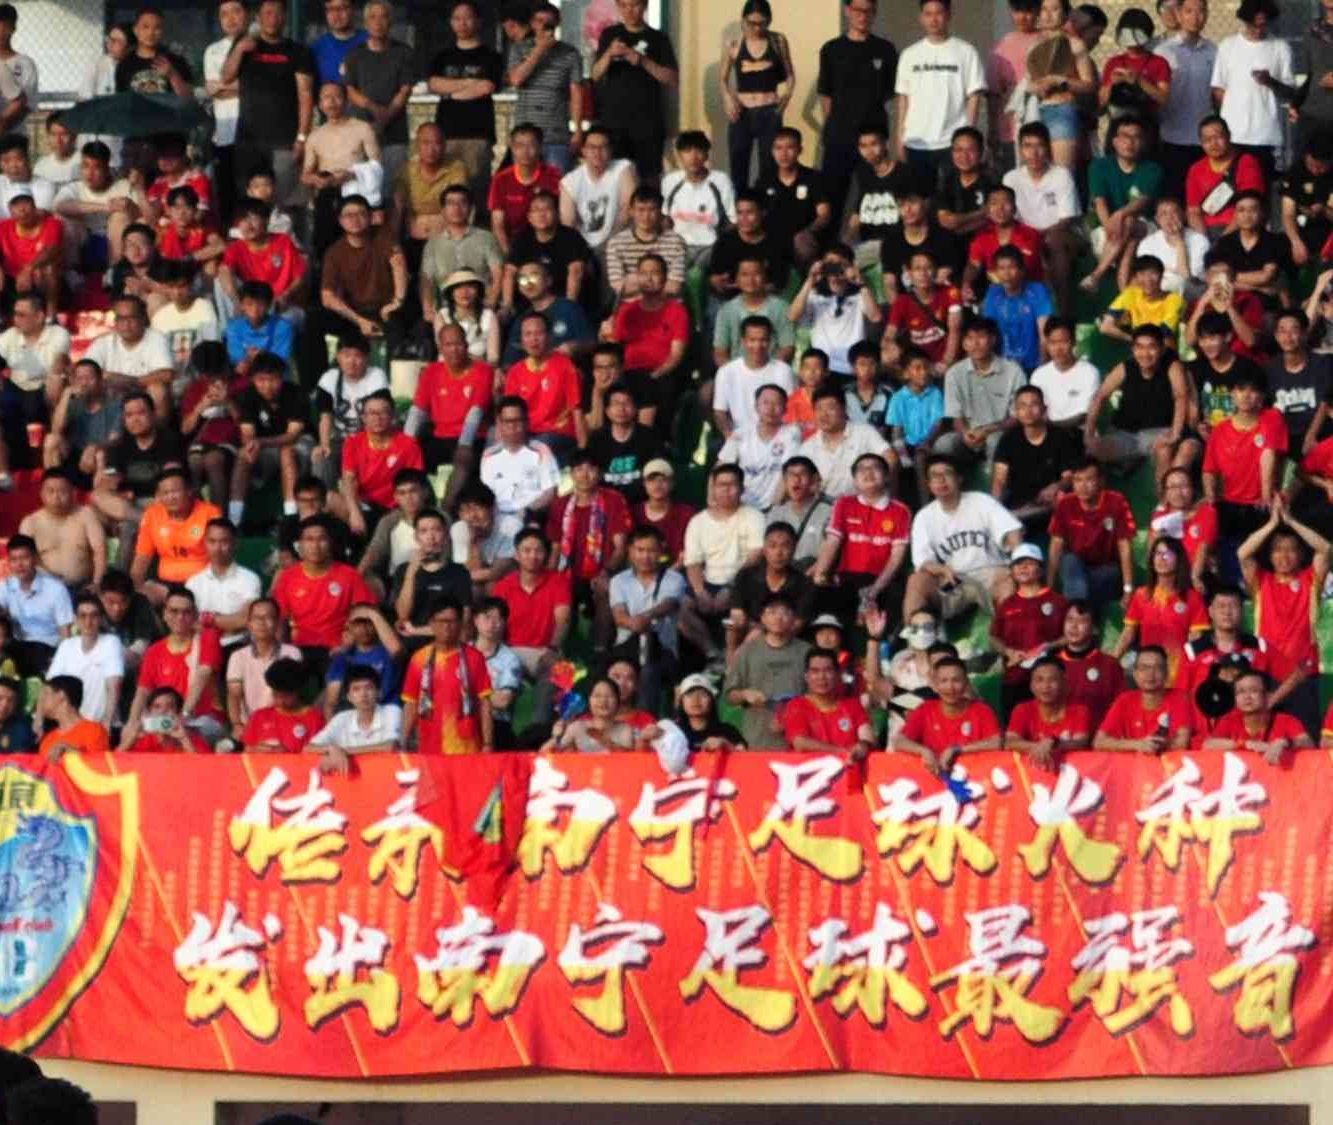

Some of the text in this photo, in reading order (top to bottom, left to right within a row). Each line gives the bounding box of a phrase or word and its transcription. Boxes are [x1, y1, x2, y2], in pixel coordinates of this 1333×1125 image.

[174, 891, 1316, 1044] 发出南宁足球最强音
